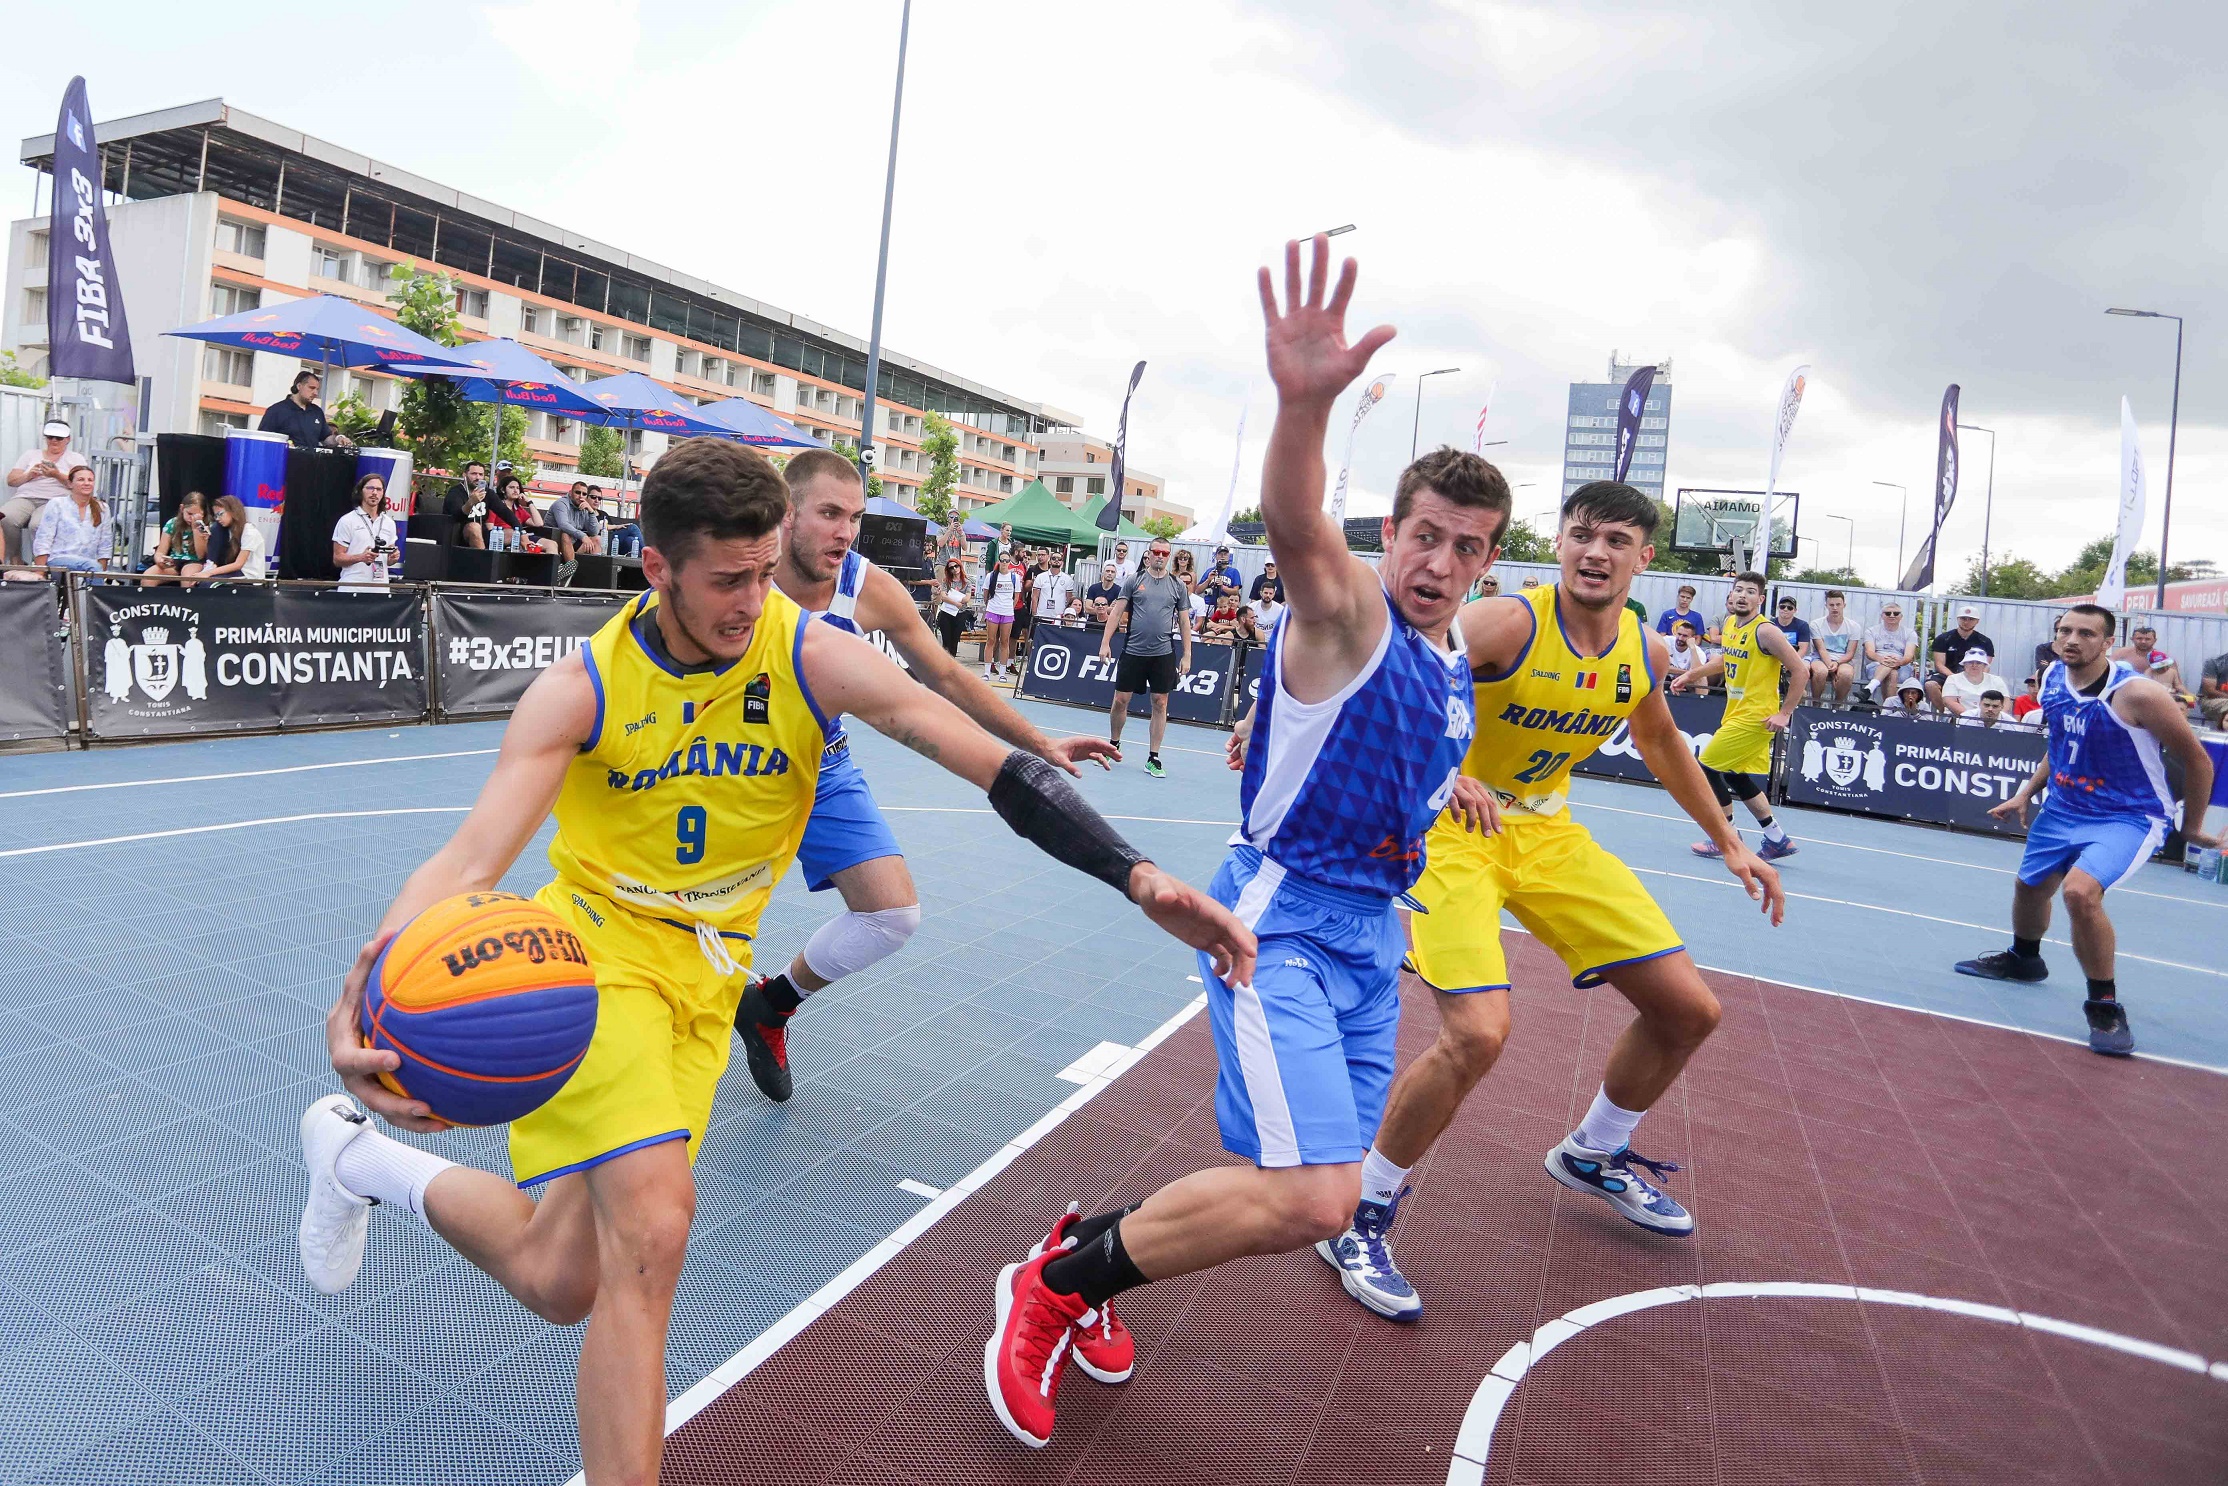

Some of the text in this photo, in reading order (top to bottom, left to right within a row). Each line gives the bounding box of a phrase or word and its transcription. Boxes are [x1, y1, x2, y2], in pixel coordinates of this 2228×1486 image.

[71, 167, 114, 350] FIBA 3x3
[257, 483, 286, 501] Red
[385, 497, 407, 512] Bull
[215, 622, 411, 644] PRIMĂRIA MUNICIPIULUI
[449, 636, 589, 671] #3x3EU
[216, 650, 413, 689] CONSTANȚA
[128, 705, 192, 718] CONSTANTIANA
[747, 700, 765, 711] FIBA
[1895, 743, 1983, 767] PRIMĂRIA
[2067, 740, 2079, 765] 7
[1512, 749, 1571, 785] 20
[675, 805, 707, 865] 9
[441, 926, 589, 977] Wilson
